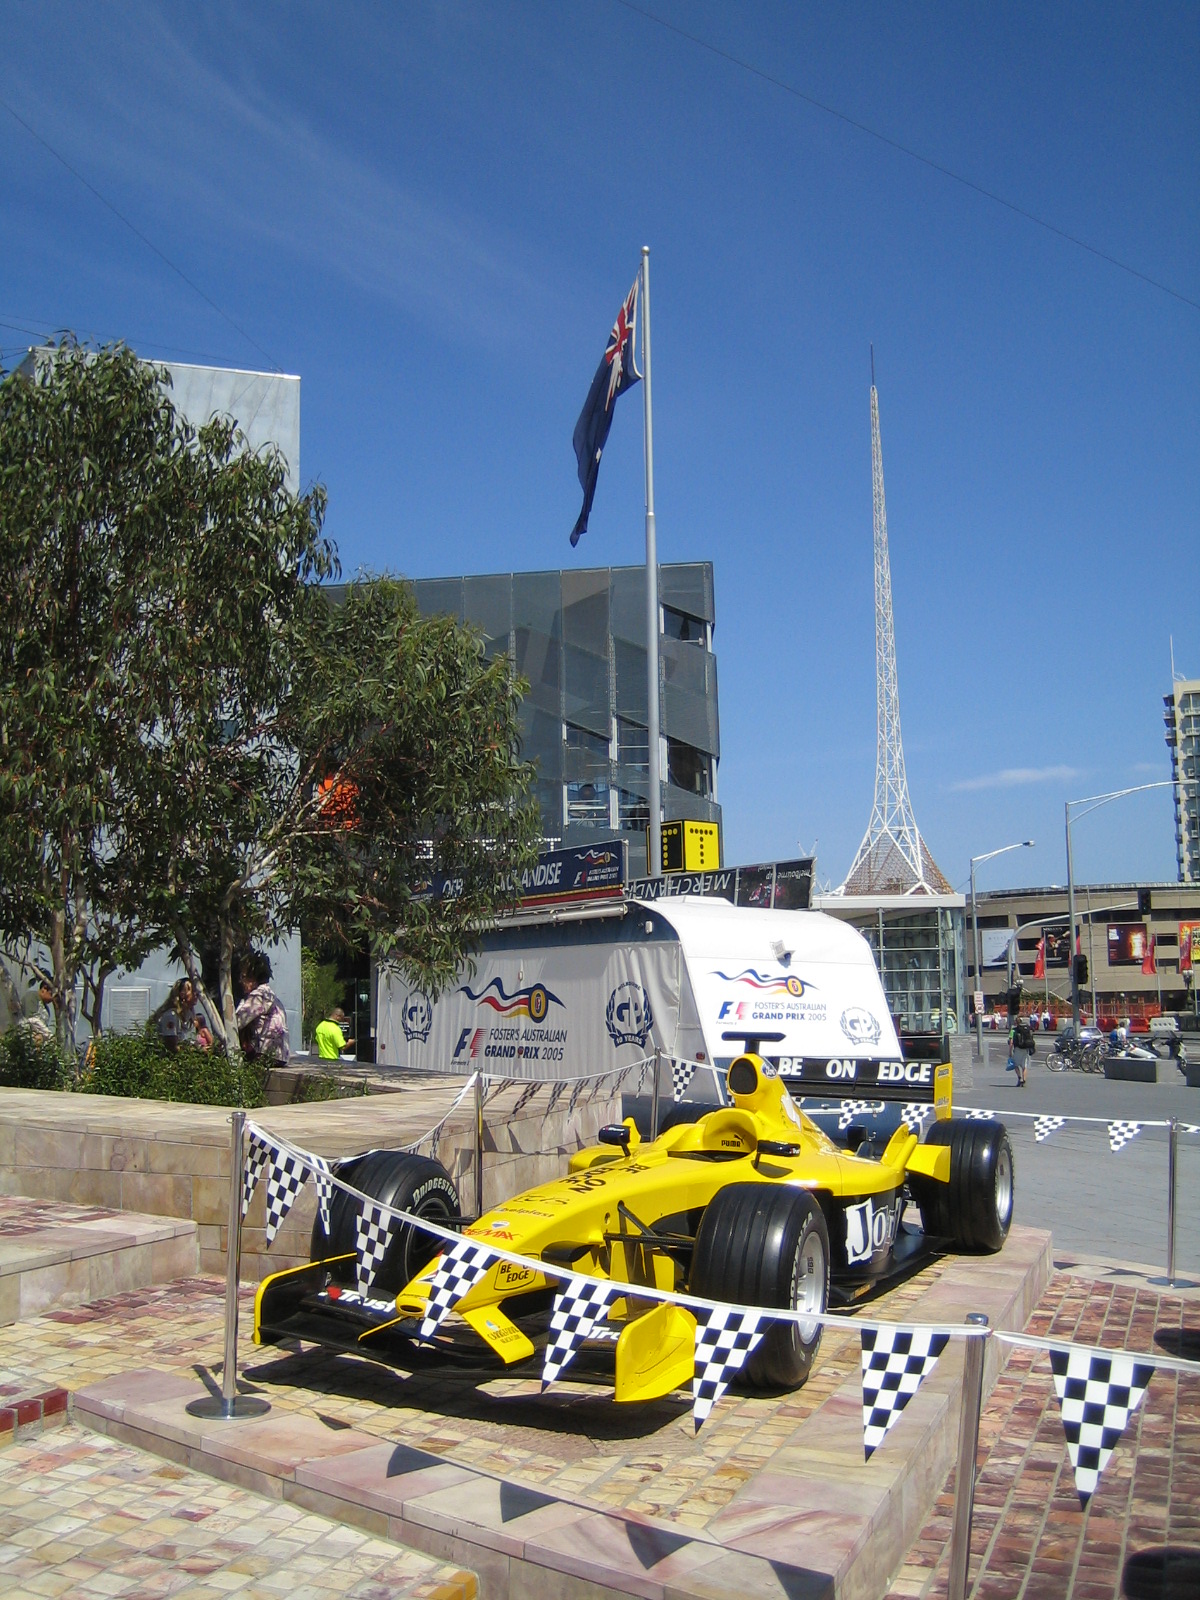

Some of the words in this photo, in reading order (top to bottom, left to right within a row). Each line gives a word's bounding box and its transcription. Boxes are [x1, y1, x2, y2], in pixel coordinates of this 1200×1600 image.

[754, 1001, 785, 1010] FOSTER'S
[786, 1001, 827, 1011] AUSTRALIAN
[752, 1012, 783, 1020] GRAND
[786, 1012, 805, 1020] PRIX
[808, 1013, 827, 1021] 2005
[489, 1028, 519, 1041] FOSTER'S
[521, 1029, 567, 1043] AUSTRALIAN
[625, 1034, 643, 1045] YEARS
[485, 1045, 515, 1057] GRAND
[541, 1047, 564, 1060] 2005
[778, 1057, 803, 1076] BE
[826, 1059, 856, 1078] ON
[877, 1062, 932, 1082] EDGE
[721, 1140, 741, 1148] PUMA
[412, 1177, 459, 1208] BRIDGESTONE
[500, 1264, 513, 1274] BE
[506, 1269, 530, 1283] EDGE
[338, 1289, 397, 1313] Trust
